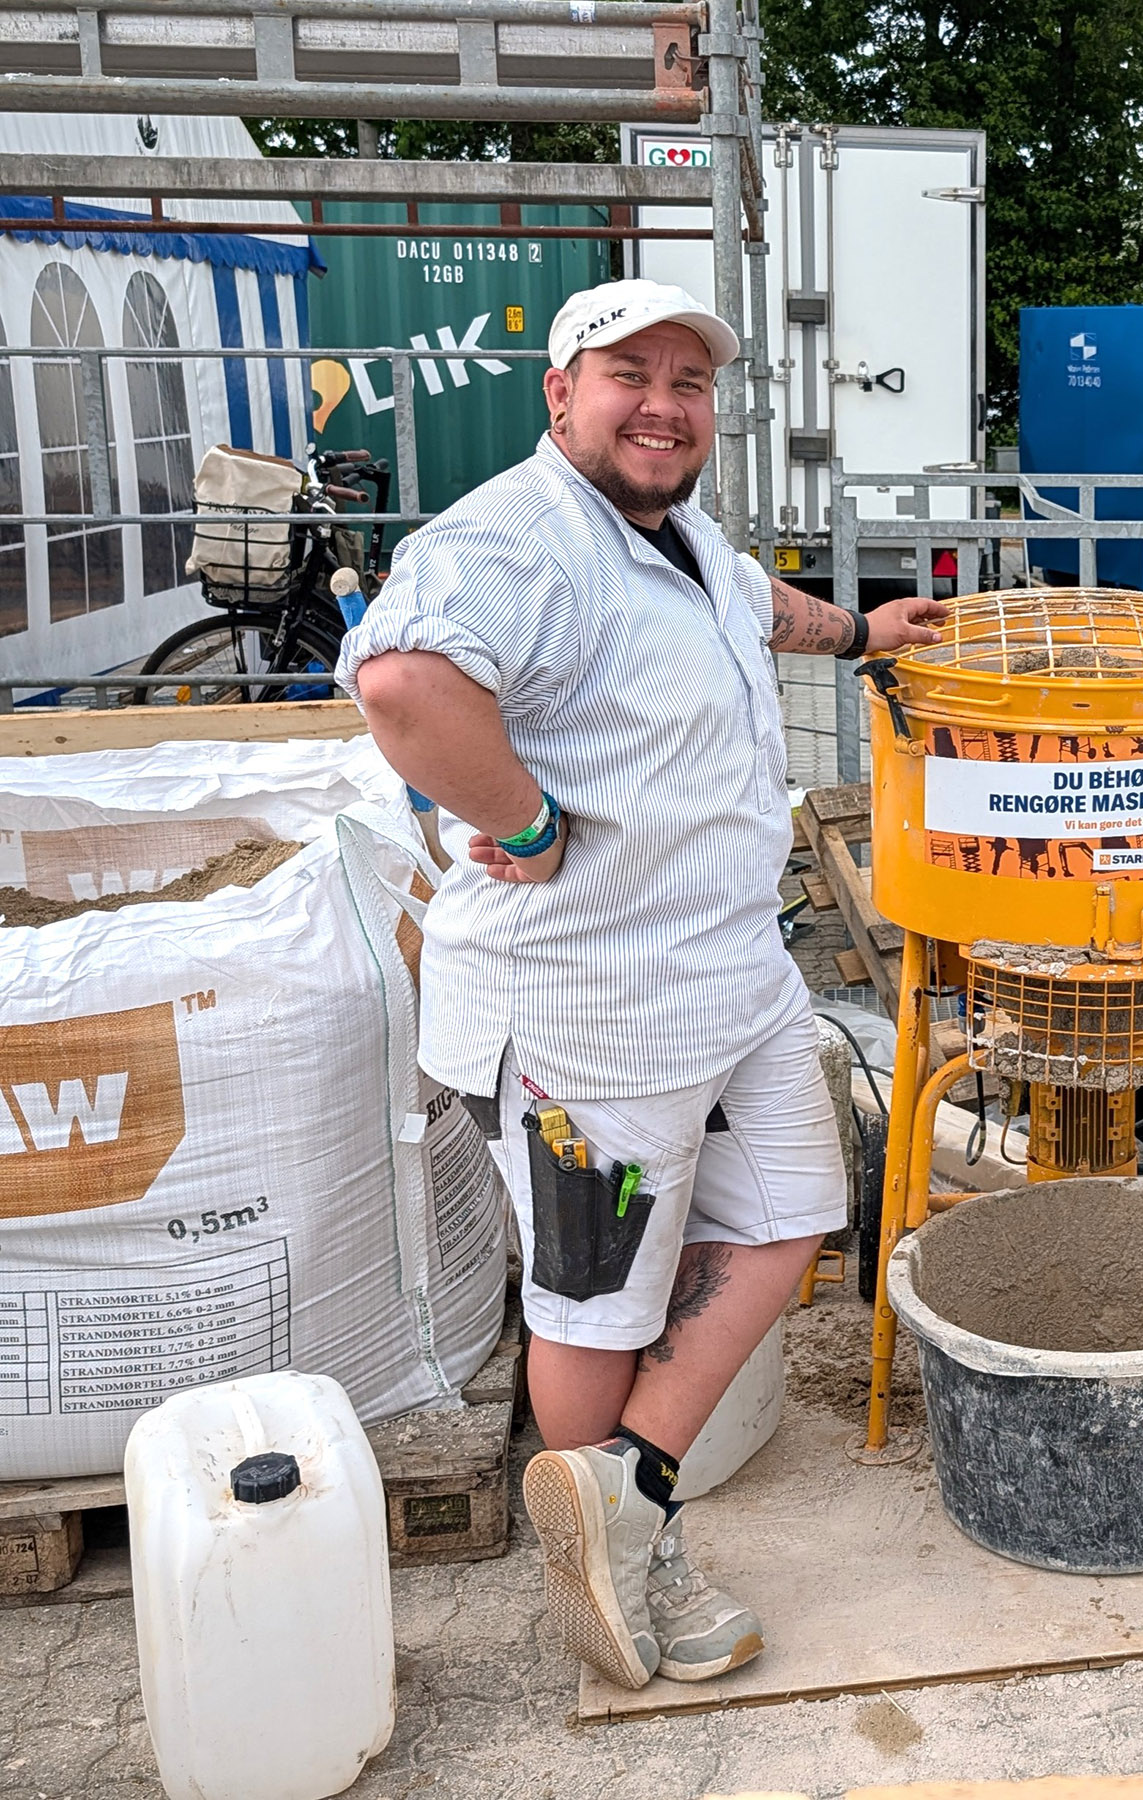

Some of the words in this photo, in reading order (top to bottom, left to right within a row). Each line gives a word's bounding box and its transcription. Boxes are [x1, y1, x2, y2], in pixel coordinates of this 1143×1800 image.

[397, 240, 441, 260] DACU
[454, 242, 518, 262] 011348
[529, 244, 541, 262] 2
[423, 265, 464, 283] 12GB
[1054, 772, 1083, 790] DU
[989, 793, 1086, 814] RENGØRE
[1065, 820, 1075, 830] Vi
[1078, 820, 1097, 829] kan
[1125, 817, 1142, 827] det
[181, 989, 216, 1014] TM
[60, 1294, 163, 1306] STRANDMØRTEL
[165, 1290, 191, 1302] 5,1%
[195, 1287, 211, 1297] 0-4
[213, 1283, 234, 1293] mm
[61, 1311, 164, 1324] STRANDMØRTEL
[166, 1307, 193, 1318] 6,6%
[196, 1304, 212, 1314] 0-2
[215, 1300, 235, 1310] mm
[62, 1327, 165, 1341] STRANDMØRTEL
[167, 1323, 194, 1335] 6,6%
[197, 1320, 213, 1330] 0-4
[216, 1316, 236, 1327] mm
[63, 1345, 165, 1359] STRANDMØRTEL
[168, 1341, 194, 1352] 7,7%
[198, 1337, 214, 1347] 0-2
[217, 1333, 237, 1344] mm
[63, 1363, 166, 1377] STRANDMØRTEL
[168, 1358, 195, 1369] 7,7%
[198, 1354, 214, 1364] 0-4
[217, 1349, 237, 1360] mm
[63, 1380, 166, 1394] STRANDMØRTEL
[168, 1375, 195, 1386] 9,0%
[198, 1370, 215, 1381] 0-2
[217, 1365, 237, 1376] mm
